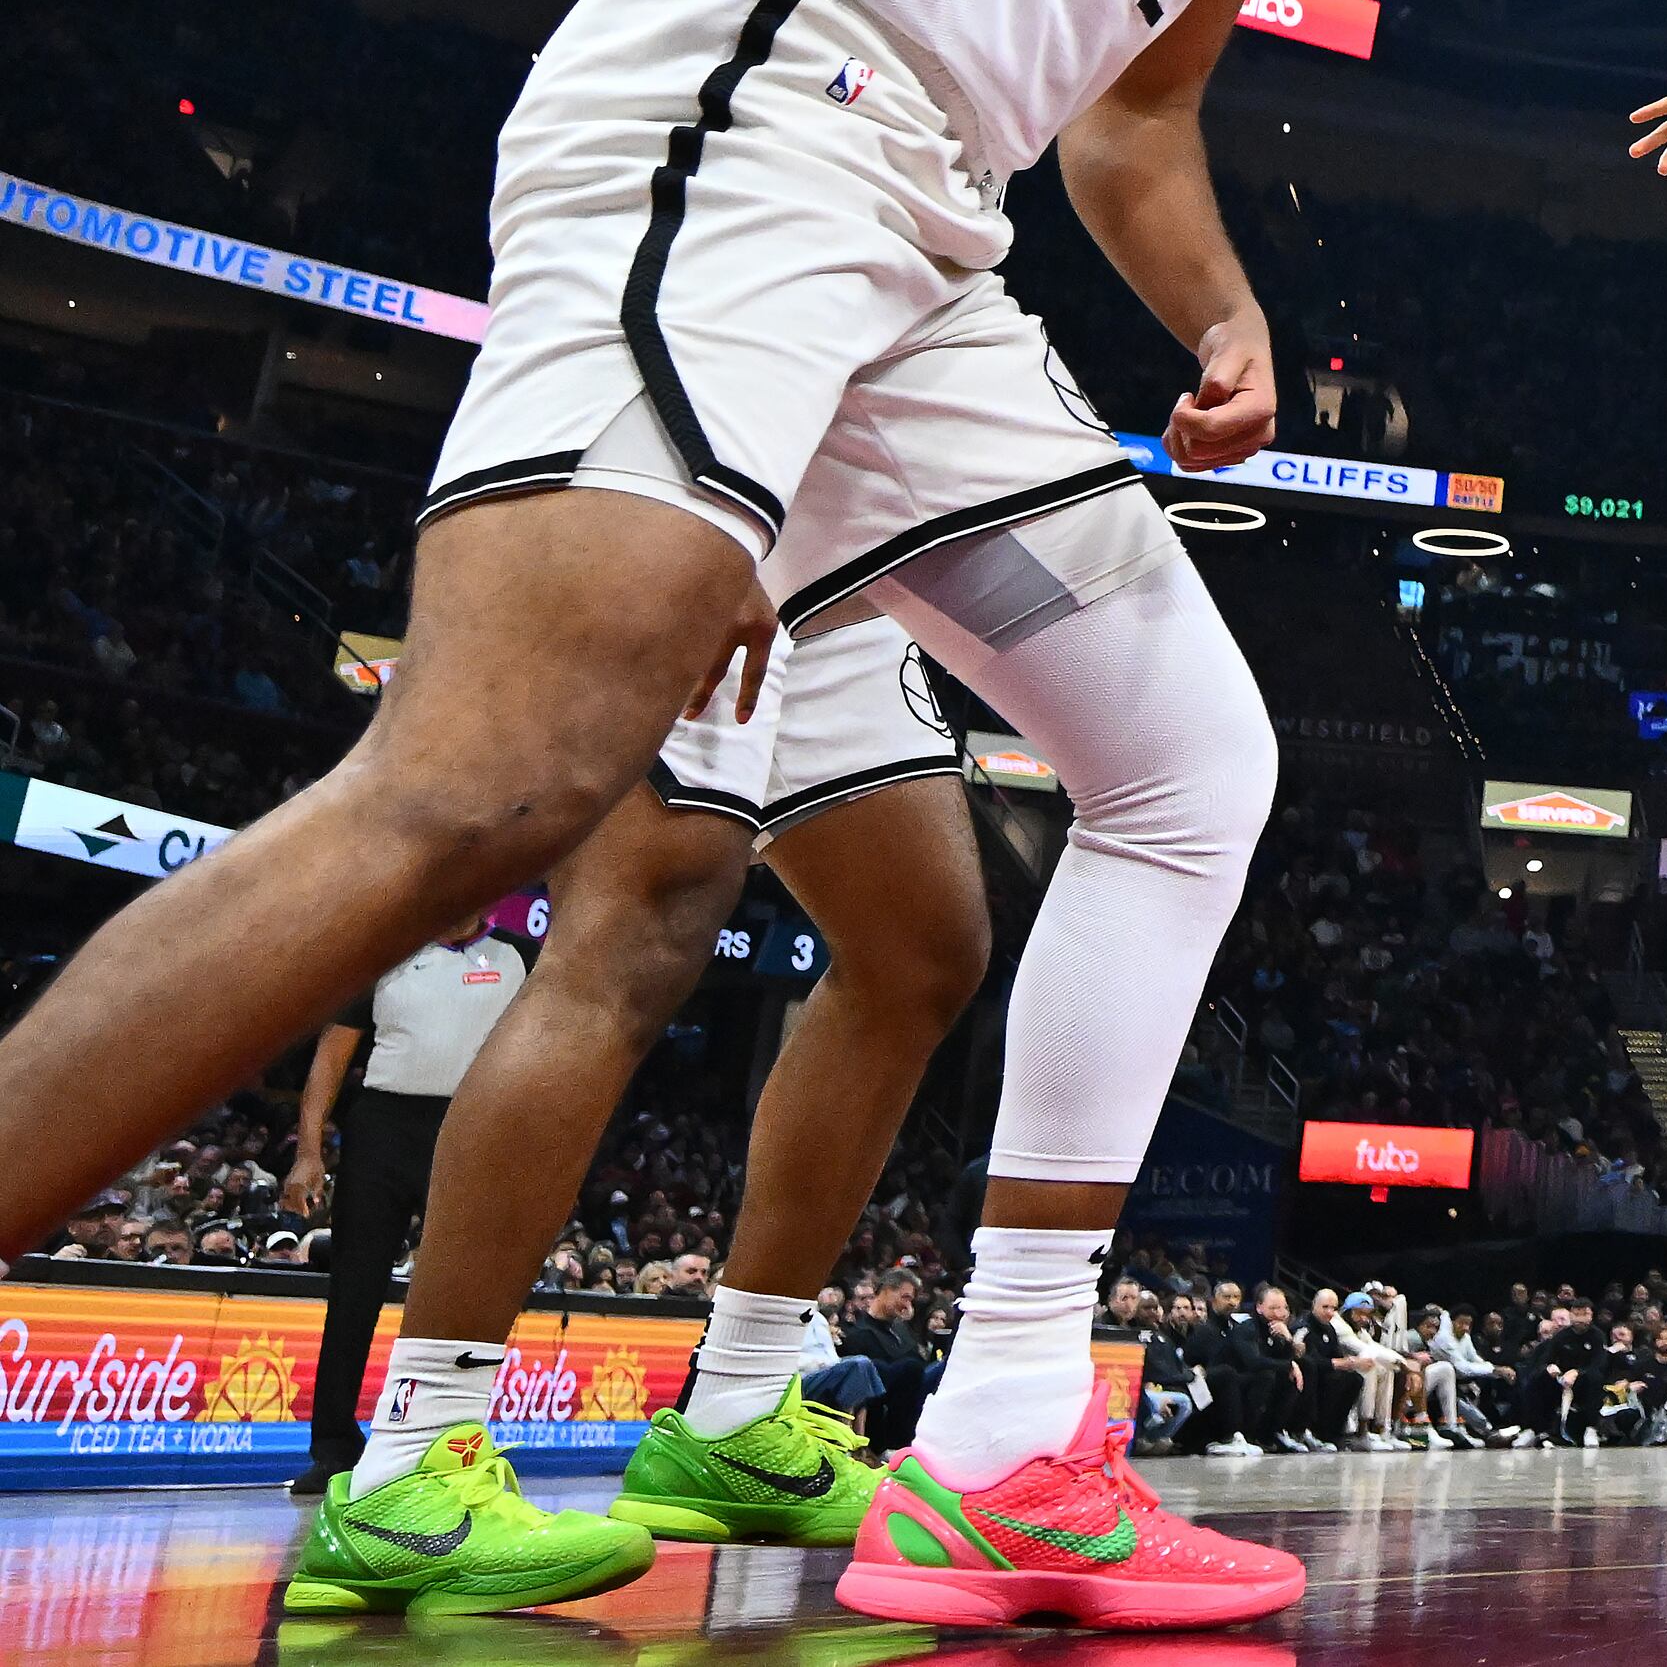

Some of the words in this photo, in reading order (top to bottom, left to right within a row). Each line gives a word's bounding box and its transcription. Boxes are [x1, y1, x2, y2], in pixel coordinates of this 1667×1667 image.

[0, 179, 271, 285] UTOMOTIVE
[284, 260, 425, 324] STEEL
[1272, 460, 1409, 495] CLIFFS
[1564, 494, 1645, 521] $9,021
[1518, 804, 1596, 825] SERVPRO
[527, 899, 549, 937] 6
[791, 935, 815, 971] 3
[1355, 1138, 1419, 1173] fubo
[1151, 1162, 1273, 1195] ECOM
[69, 1423, 121, 1453] ICED
[126, 1423, 165, 1453] TEA
[190, 1423, 254, 1453] VODKA
[569, 1423, 617, 1447] VODKA
